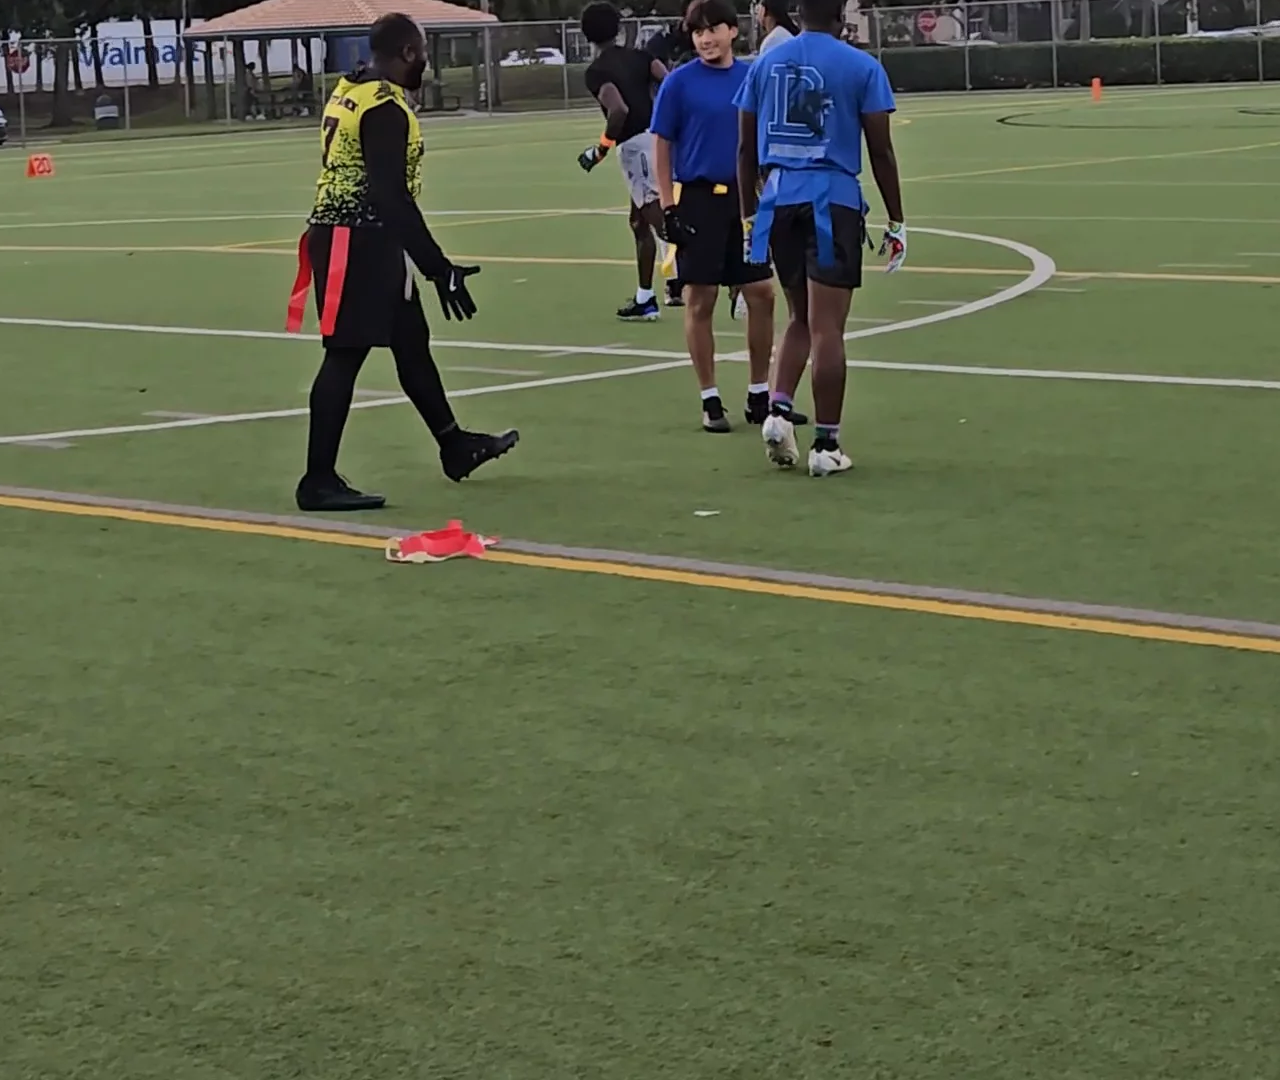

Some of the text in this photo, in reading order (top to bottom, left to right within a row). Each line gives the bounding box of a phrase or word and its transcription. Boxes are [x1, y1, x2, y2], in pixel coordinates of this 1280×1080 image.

[76, 41, 199, 66] Walmat
[322, 116, 340, 170] 7
[34, 156, 52, 174] 20
